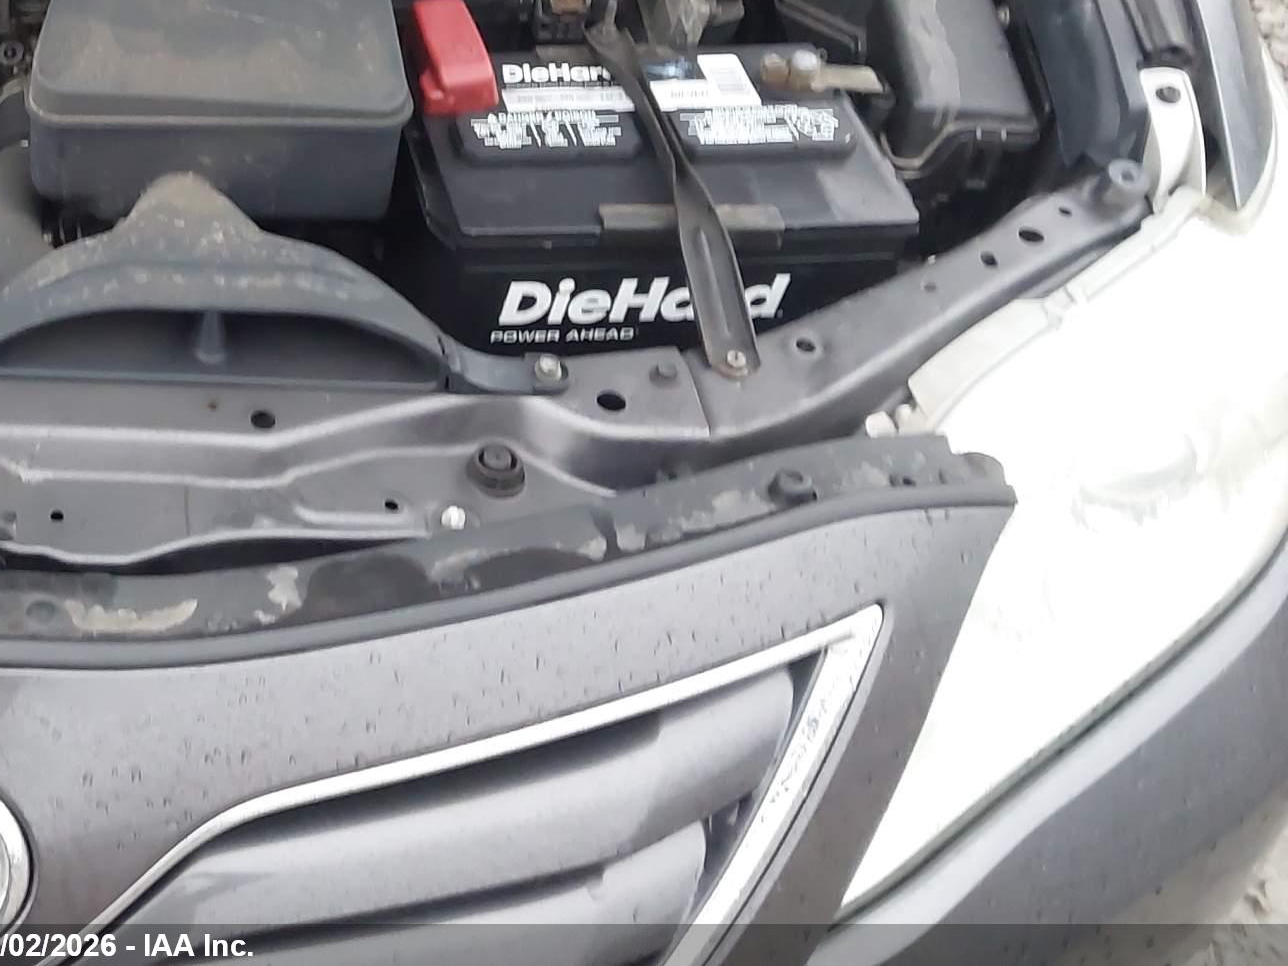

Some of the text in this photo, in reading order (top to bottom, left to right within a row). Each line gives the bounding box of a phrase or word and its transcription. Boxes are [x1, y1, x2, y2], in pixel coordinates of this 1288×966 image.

[498, 272, 792, 326] DieHad
[490, 326, 635, 344] POWER AHEAD
